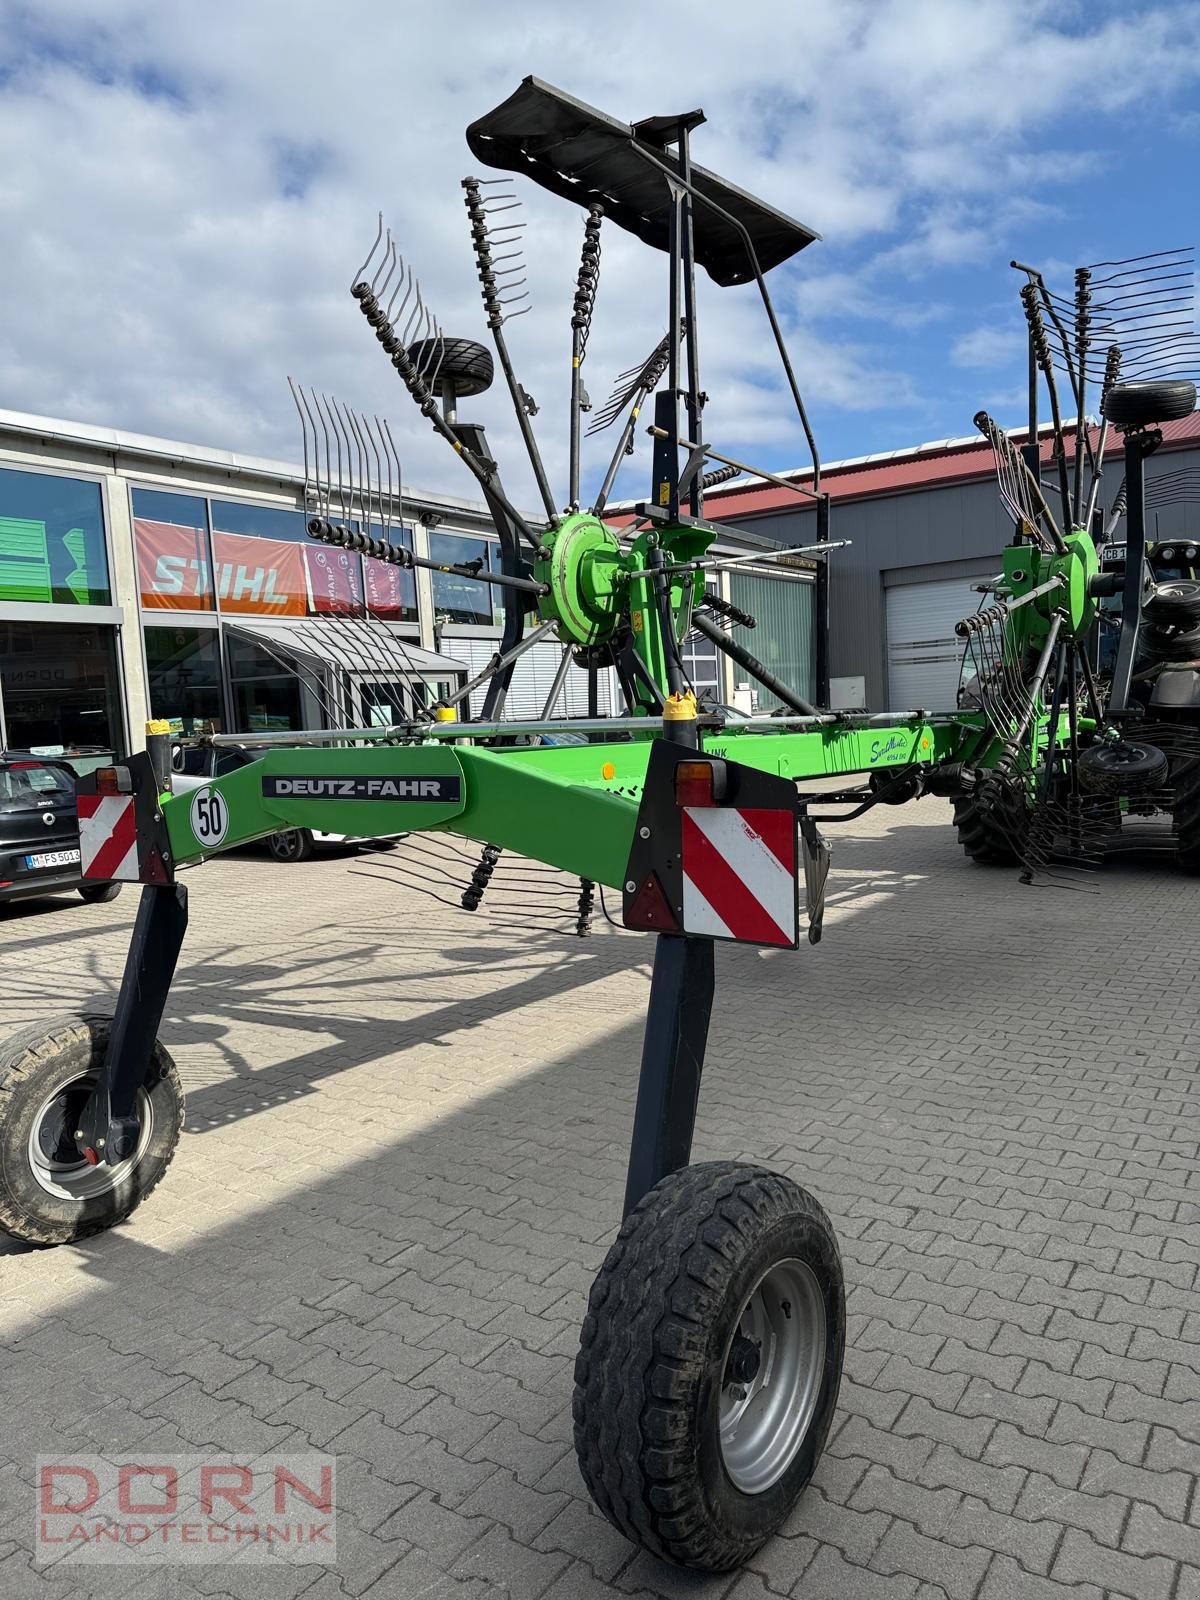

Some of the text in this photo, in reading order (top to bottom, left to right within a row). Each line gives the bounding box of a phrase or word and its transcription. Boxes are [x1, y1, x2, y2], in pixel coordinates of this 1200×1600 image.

[1106, 549, 1118, 559] CB
[152, 554, 289, 605] STIHL
[275, 779, 441, 797] DEUTZ-FAHR
[197, 797, 222, 836] 50
[32, 850, 80, 866] M FS 5013
